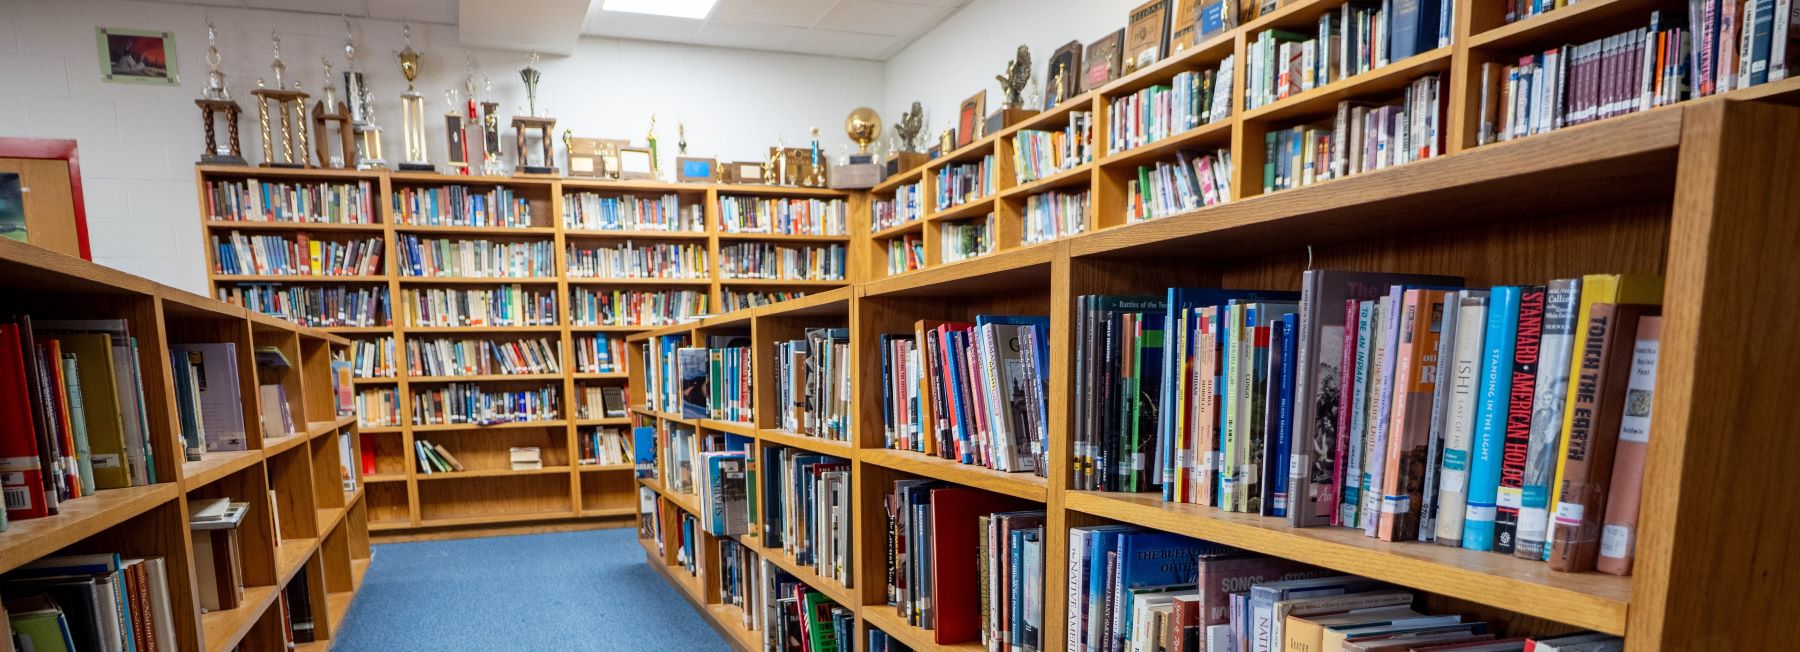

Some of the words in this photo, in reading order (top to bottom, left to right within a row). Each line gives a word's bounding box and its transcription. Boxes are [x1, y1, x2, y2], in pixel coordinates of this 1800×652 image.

[1140, 300, 1147, 308] of
[1361, 307, 1368, 318] TO
[1360, 320, 1367, 331] BE
[1515, 291, 1544, 364] STANNARD
[1358, 335, 1366, 348] AN
[1582, 316, 1607, 369] TOUCH
[1356, 351, 1365, 383] INDIAN
[1375, 348, 1384, 373] Hopi
[1487, 348, 1500, 397] STANDING
[1456, 360, 1472, 394] ISHI
[1577, 373, 1598, 403] THE
[1371, 376, 1382, 420] Kachina
[1456, 399, 1464, 419] LAST
[1486, 399, 1494, 411] IN
[1507, 372, 1535, 438] AMERICAN
[1455, 421, 1462, 432] OF
[1484, 414, 1492, 430] THE
[1568, 408, 1592, 462] EARTH
[1369, 426, 1377, 453] Dolls
[1481, 433, 1490, 461] LIGHT
[1498, 441, 1528, 516] HOLOCT
[713, 475, 723, 516] SHARKS
[1136, 551, 1158, 560] THE
[1070, 560, 1078, 608] NATIVE
